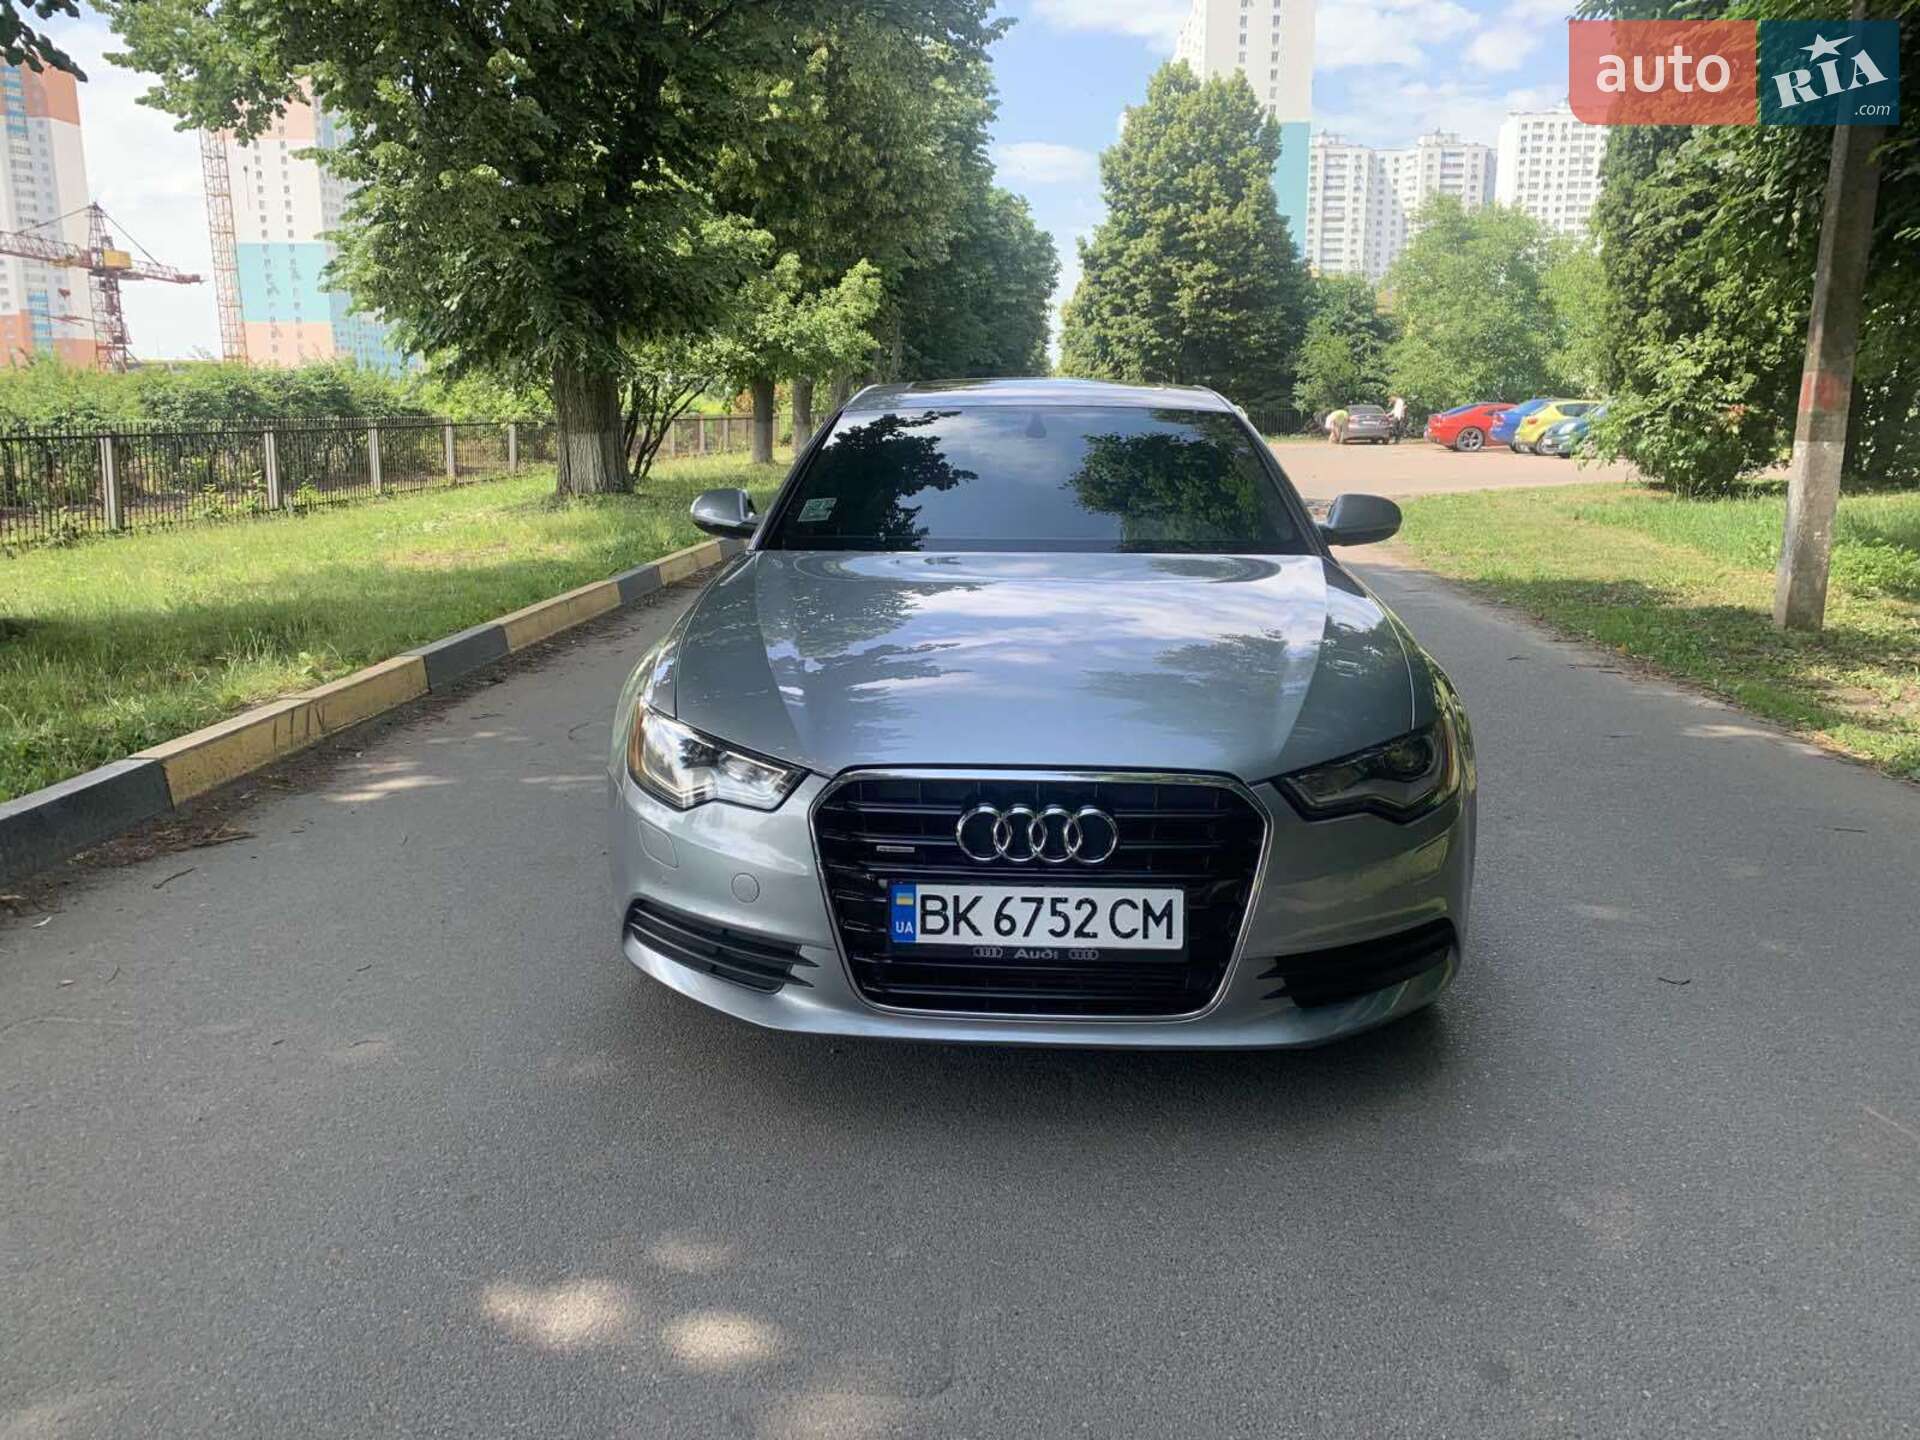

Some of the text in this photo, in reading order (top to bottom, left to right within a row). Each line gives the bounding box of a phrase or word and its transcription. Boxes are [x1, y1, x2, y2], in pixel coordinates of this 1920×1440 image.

[919, 894, 1174, 940] BK 6752 CM
[895, 921, 914, 934] UA
[1013, 948, 1059, 960] Audi
